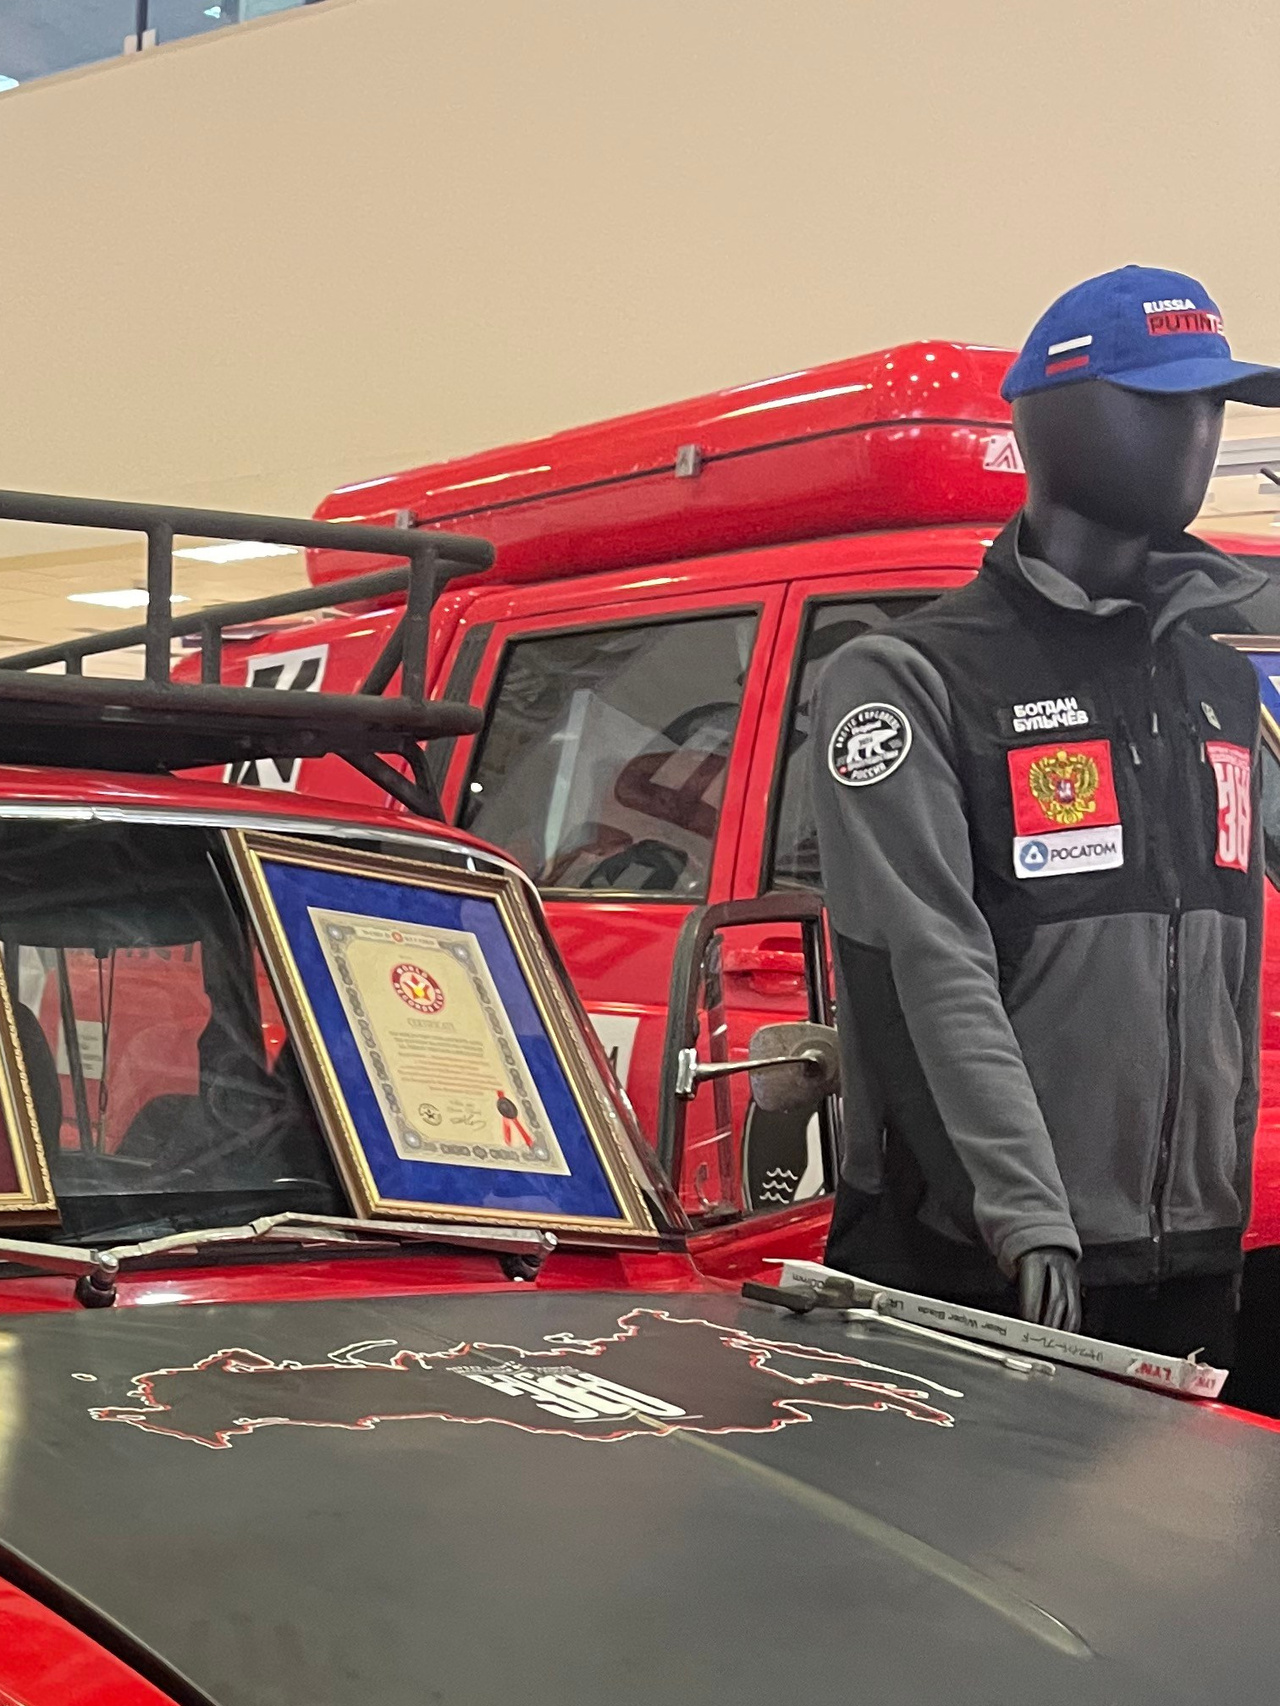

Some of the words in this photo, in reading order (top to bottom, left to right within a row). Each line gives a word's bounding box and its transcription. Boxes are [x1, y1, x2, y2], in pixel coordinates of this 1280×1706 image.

[1013, 696, 1078, 718] БОГДАН
[1050, 843, 1117, 862] РОСАТОМ
[1133, 1361, 1172, 1382] LYN
